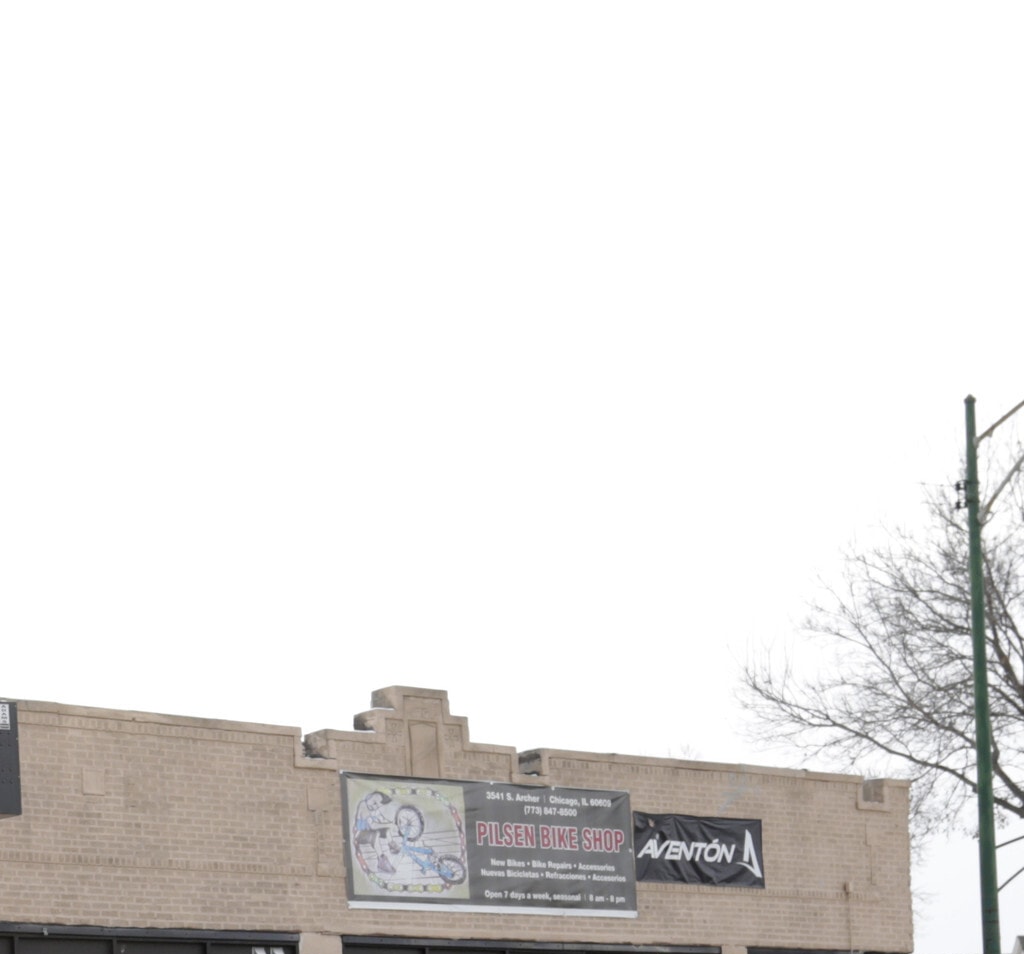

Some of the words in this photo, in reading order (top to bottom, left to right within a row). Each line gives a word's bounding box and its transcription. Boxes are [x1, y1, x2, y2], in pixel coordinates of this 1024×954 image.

[506, 792, 514, 801] S.
[516, 793, 540, 803] Archer
[549, 795, 581, 807] Chicago,
[581, 797, 589, 806] IL
[524, 805, 543, 816] (773)
[476, 821, 536, 848] PILSEN
[539, 824, 579, 851] BIKE
[582, 827, 624, 853] SHOP
[490, 858, 506, 866] New
[506, 859, 526, 867] Bikes
[531, 860, 547, 868] Bike
[547, 861, 573, 870] Repairs
[480, 868, 506, 877] Nuevas
[484, 890, 503, 900] Open
[510, 891, 526, 900] days
